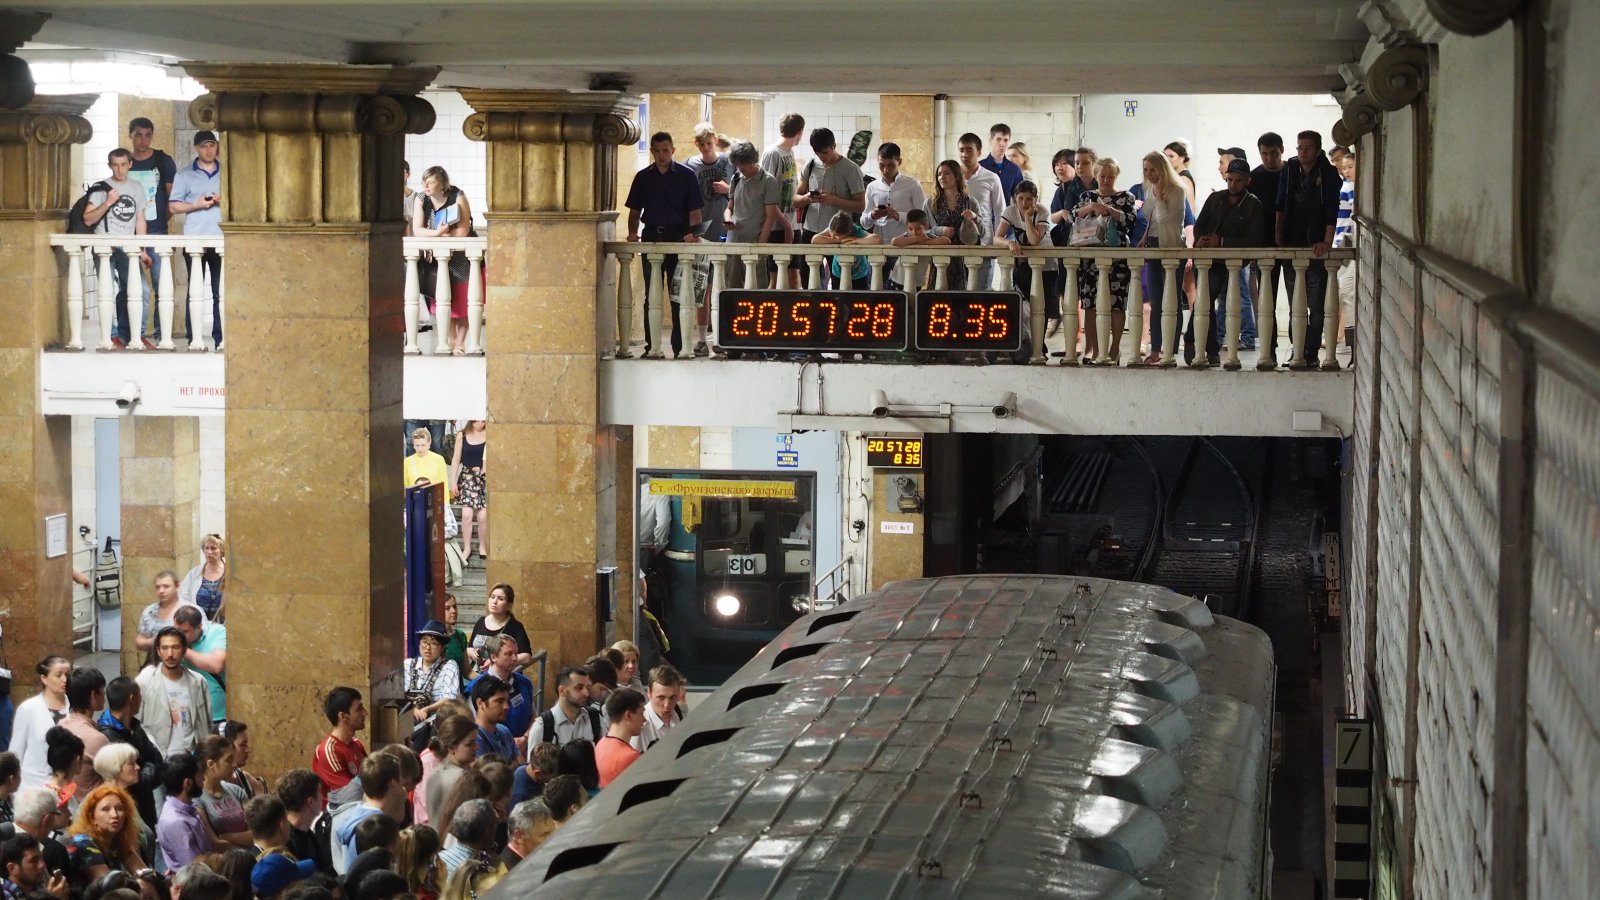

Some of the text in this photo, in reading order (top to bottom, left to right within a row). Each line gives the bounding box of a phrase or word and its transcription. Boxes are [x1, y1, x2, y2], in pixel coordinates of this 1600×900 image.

[928, 303, 1008, 338] 8.35
[179, 386, 193, 396] НЕТ
[667, 483, 751, 497] «Фрунзенская»
[752, 485, 795, 498] закрыта
[1343, 727, 1361, 764] 7
